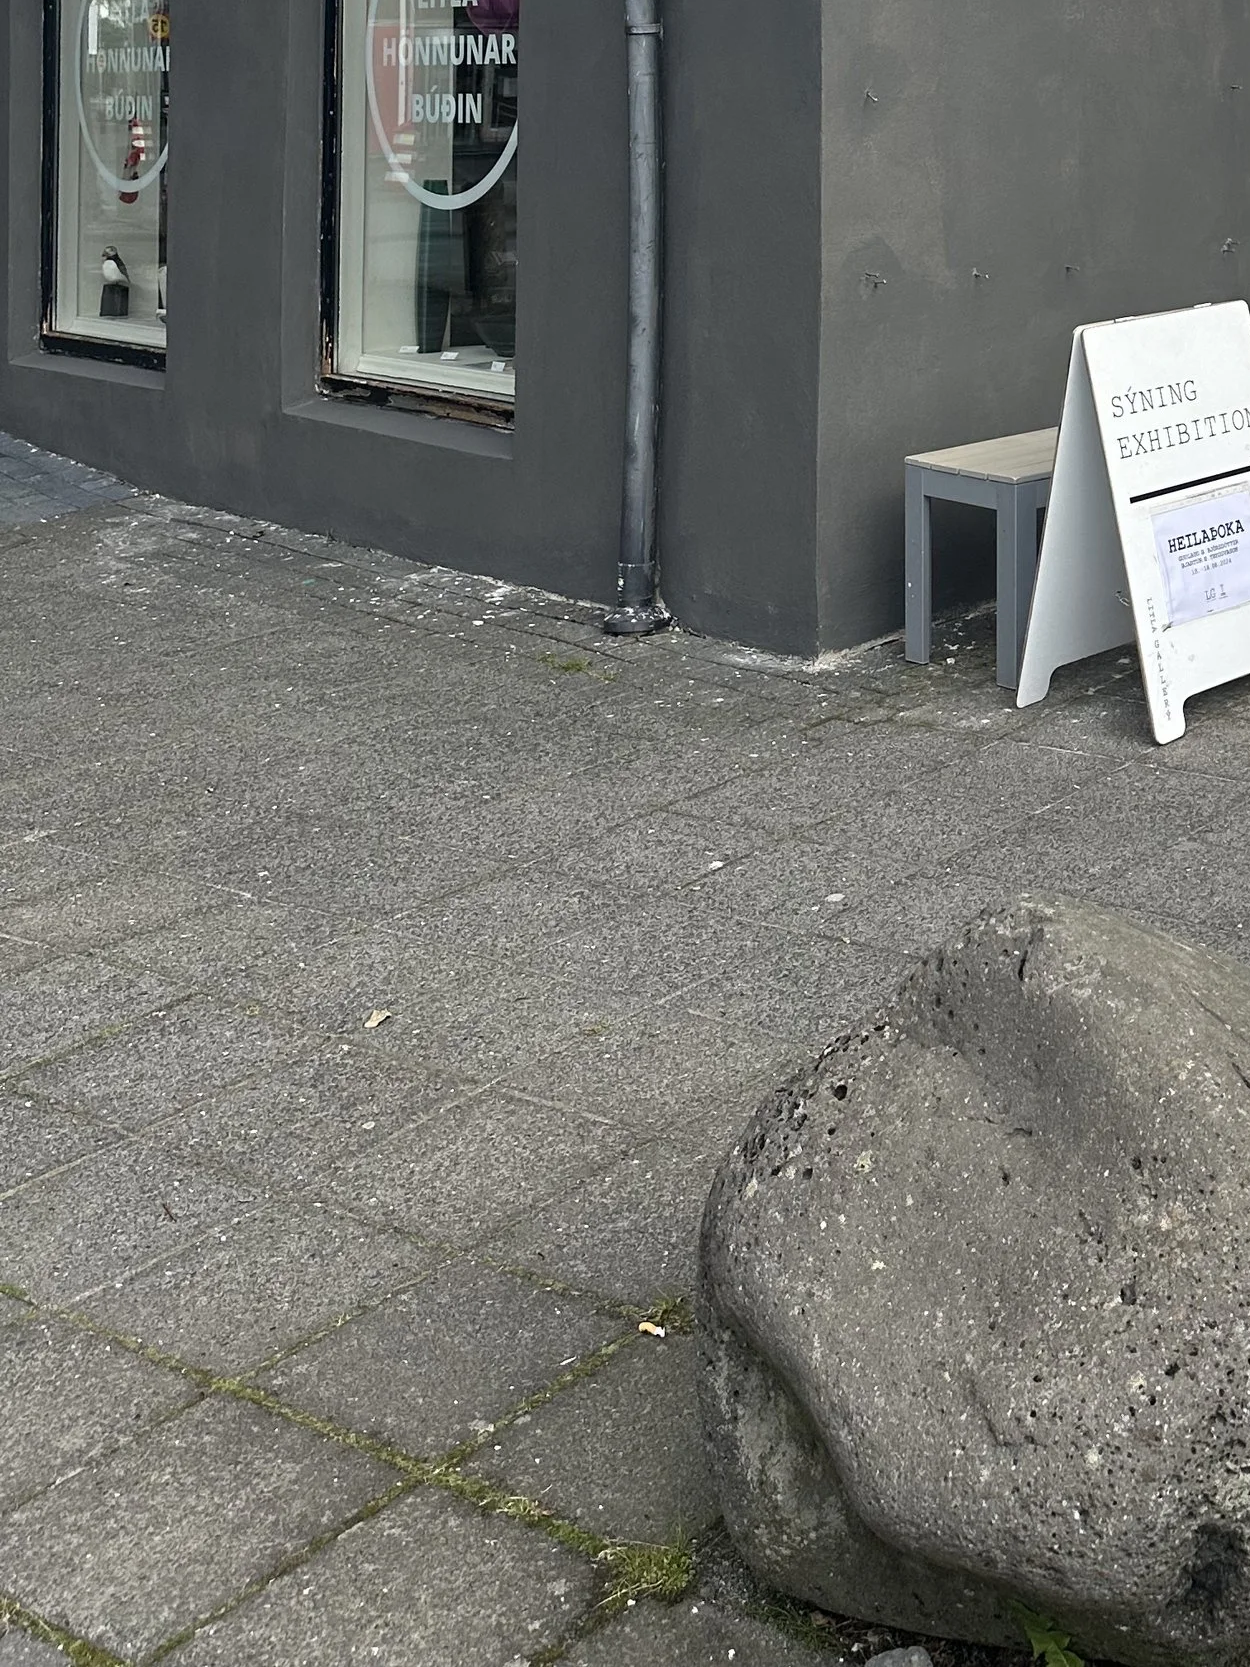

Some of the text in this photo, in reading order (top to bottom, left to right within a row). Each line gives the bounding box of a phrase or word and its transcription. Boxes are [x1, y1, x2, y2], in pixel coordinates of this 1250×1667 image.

[382, 30, 517, 67] HÖNNUNAR
[105, 89, 153, 121] BÚÐIN
[411, 85, 483, 125] BÚÐIN
[1111, 379, 1197, 418] SÝNING
[1167, 519, 1245, 553] HEILAÞOKA
